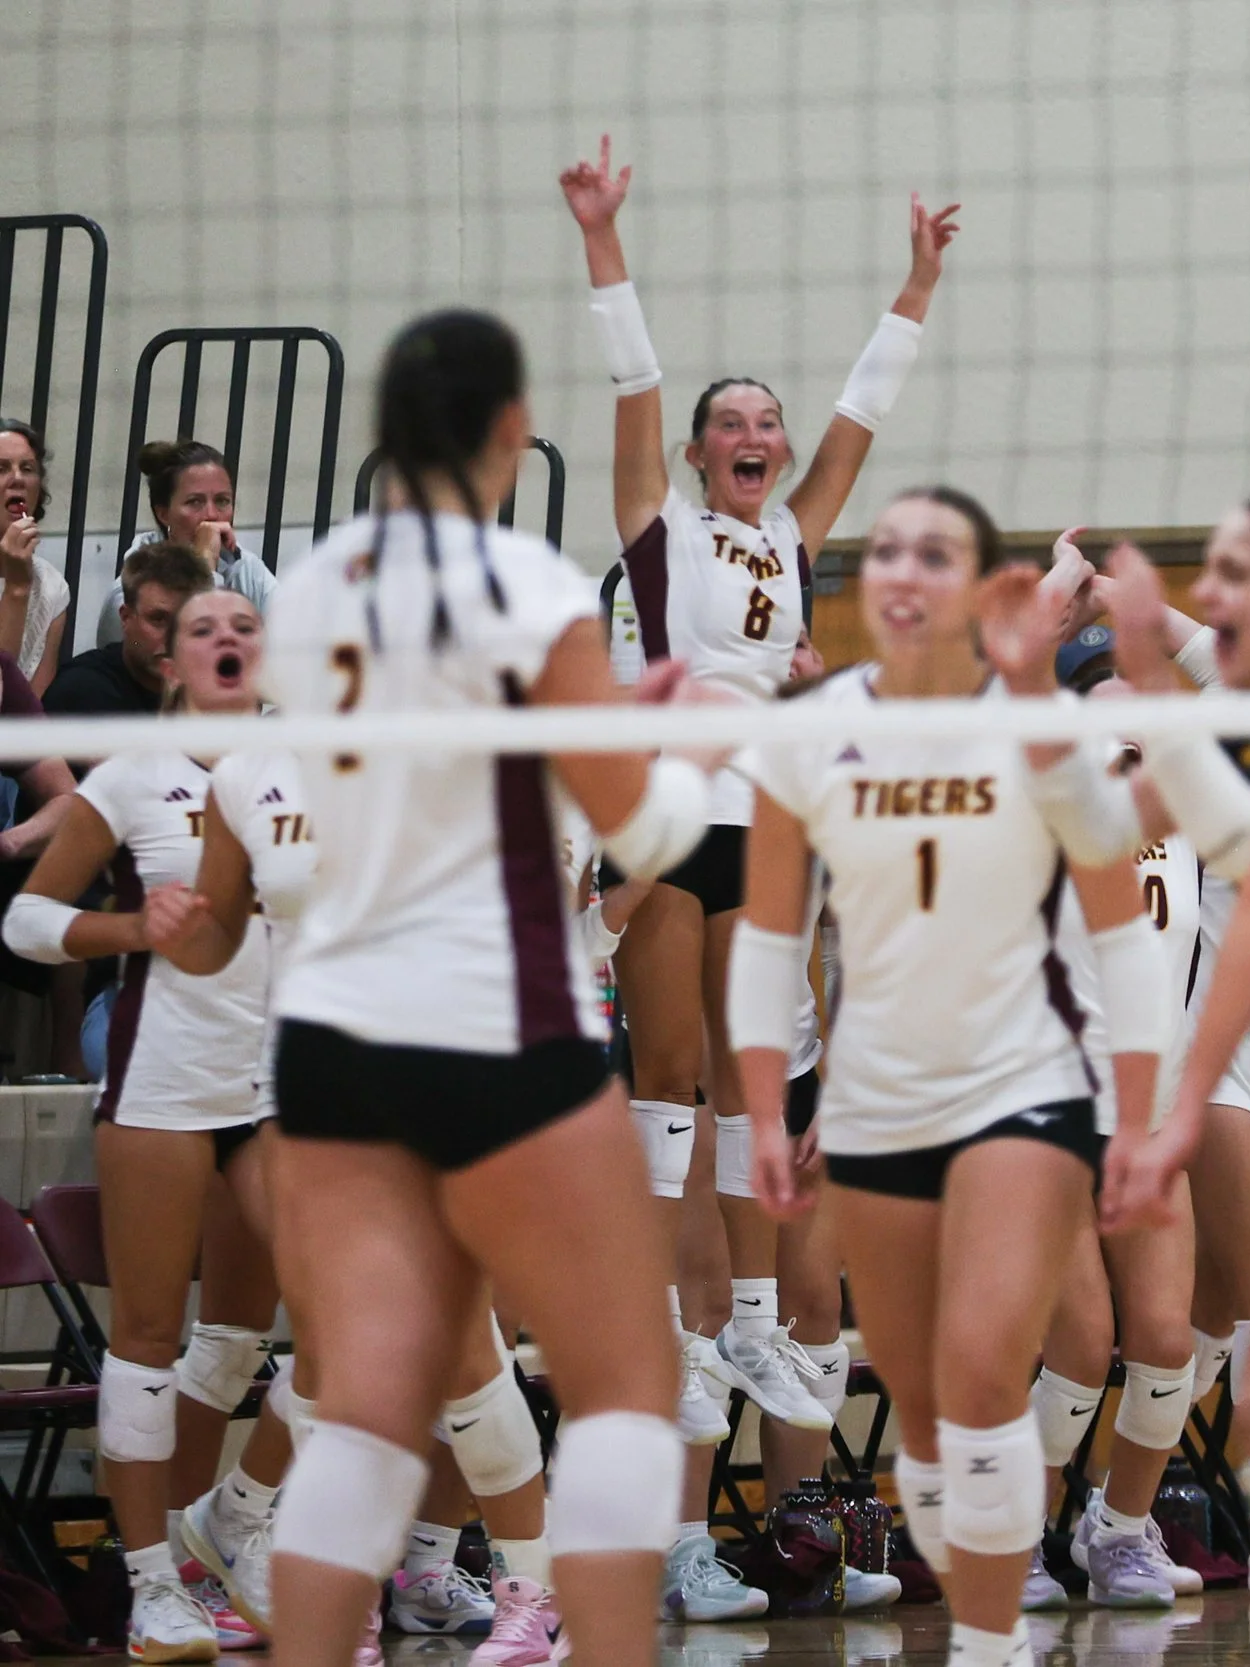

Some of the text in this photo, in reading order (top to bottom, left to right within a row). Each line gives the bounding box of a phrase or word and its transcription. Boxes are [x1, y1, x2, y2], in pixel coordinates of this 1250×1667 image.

[743, 584, 776, 642] 8
[851, 774, 998, 820] TIGERS
[916, 836, 937, 914] 1
